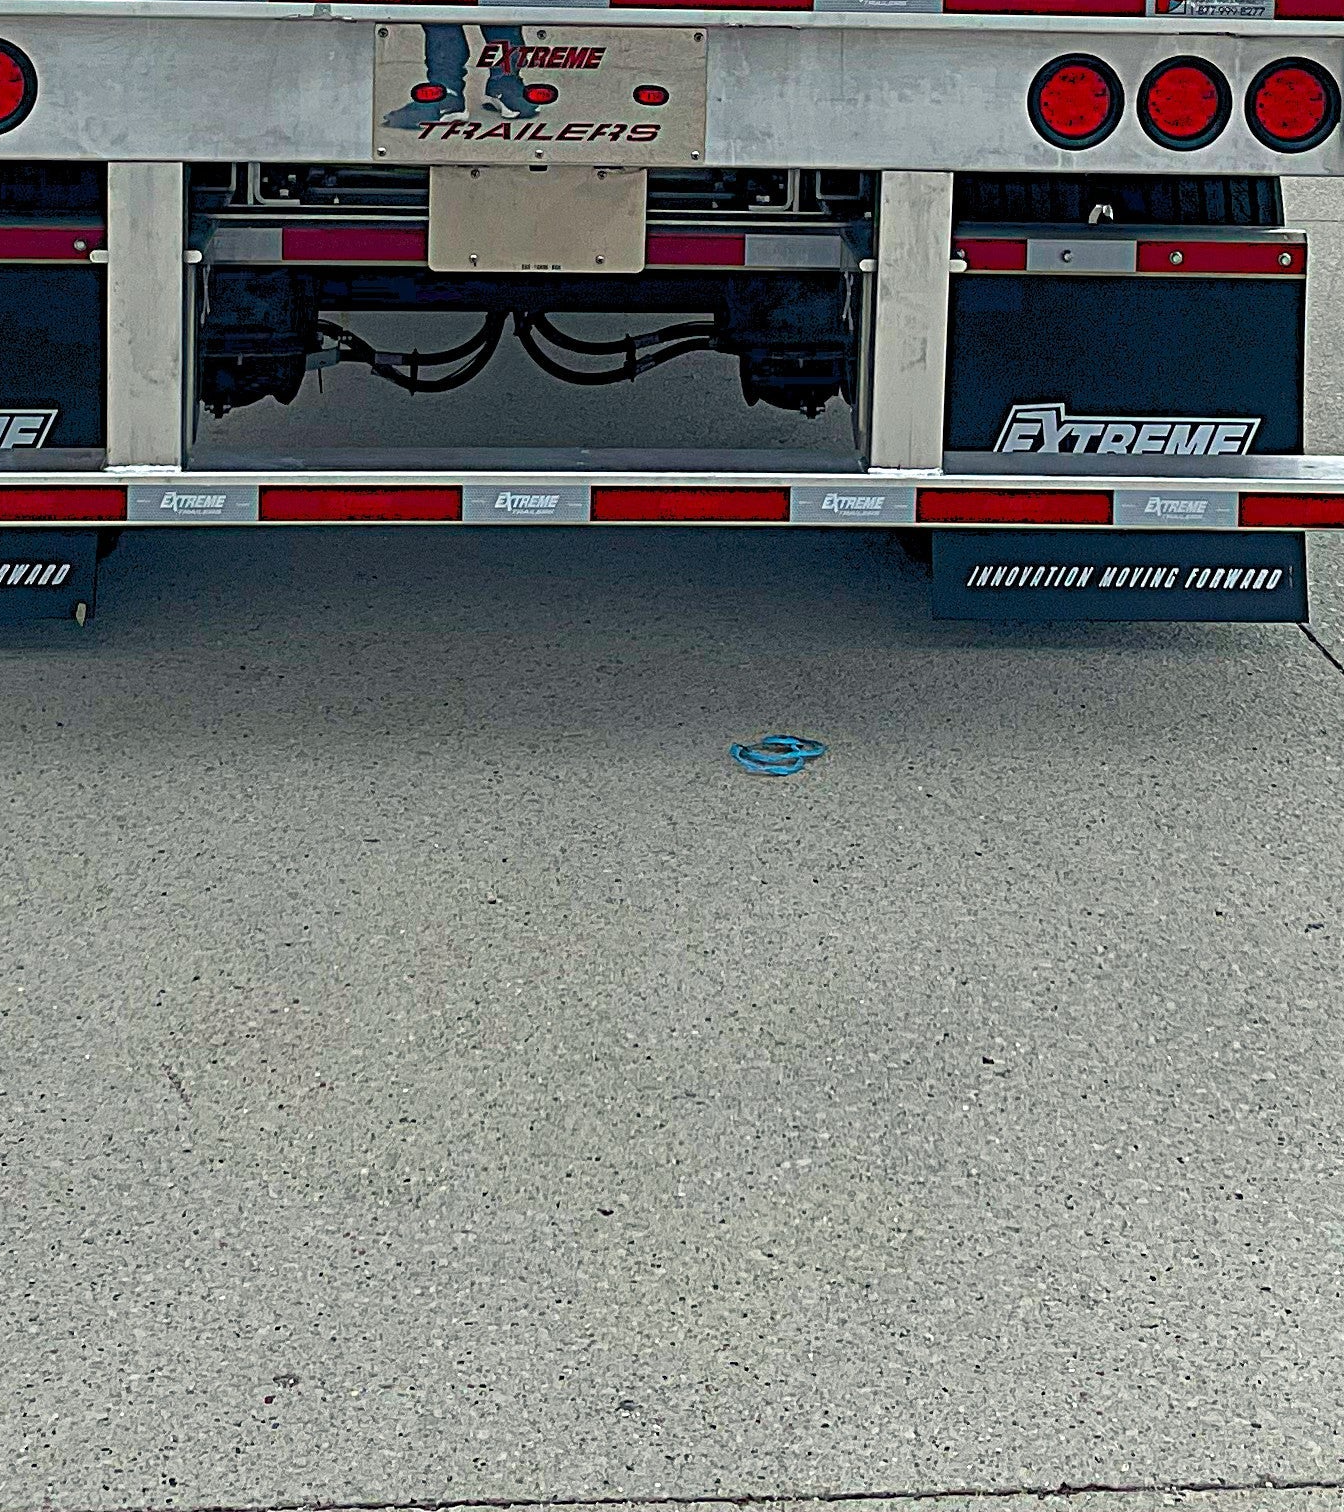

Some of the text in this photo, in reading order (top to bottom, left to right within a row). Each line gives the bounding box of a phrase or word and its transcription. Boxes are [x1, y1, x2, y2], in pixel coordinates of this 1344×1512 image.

[476, 40, 607, 74] EXTREME
[416, 121, 661, 142] TRAILERS
[1001, 410, 1249, 455] EXTREME
[160, 491, 226, 512] EXTREME
[495, 491, 560, 511] EXTREME
[821, 492, 885, 513] EXTREME
[1144, 496, 1208, 516] EXTREME
[966, 565, 1283, 590] INNOVATION MOVING FORWARD
